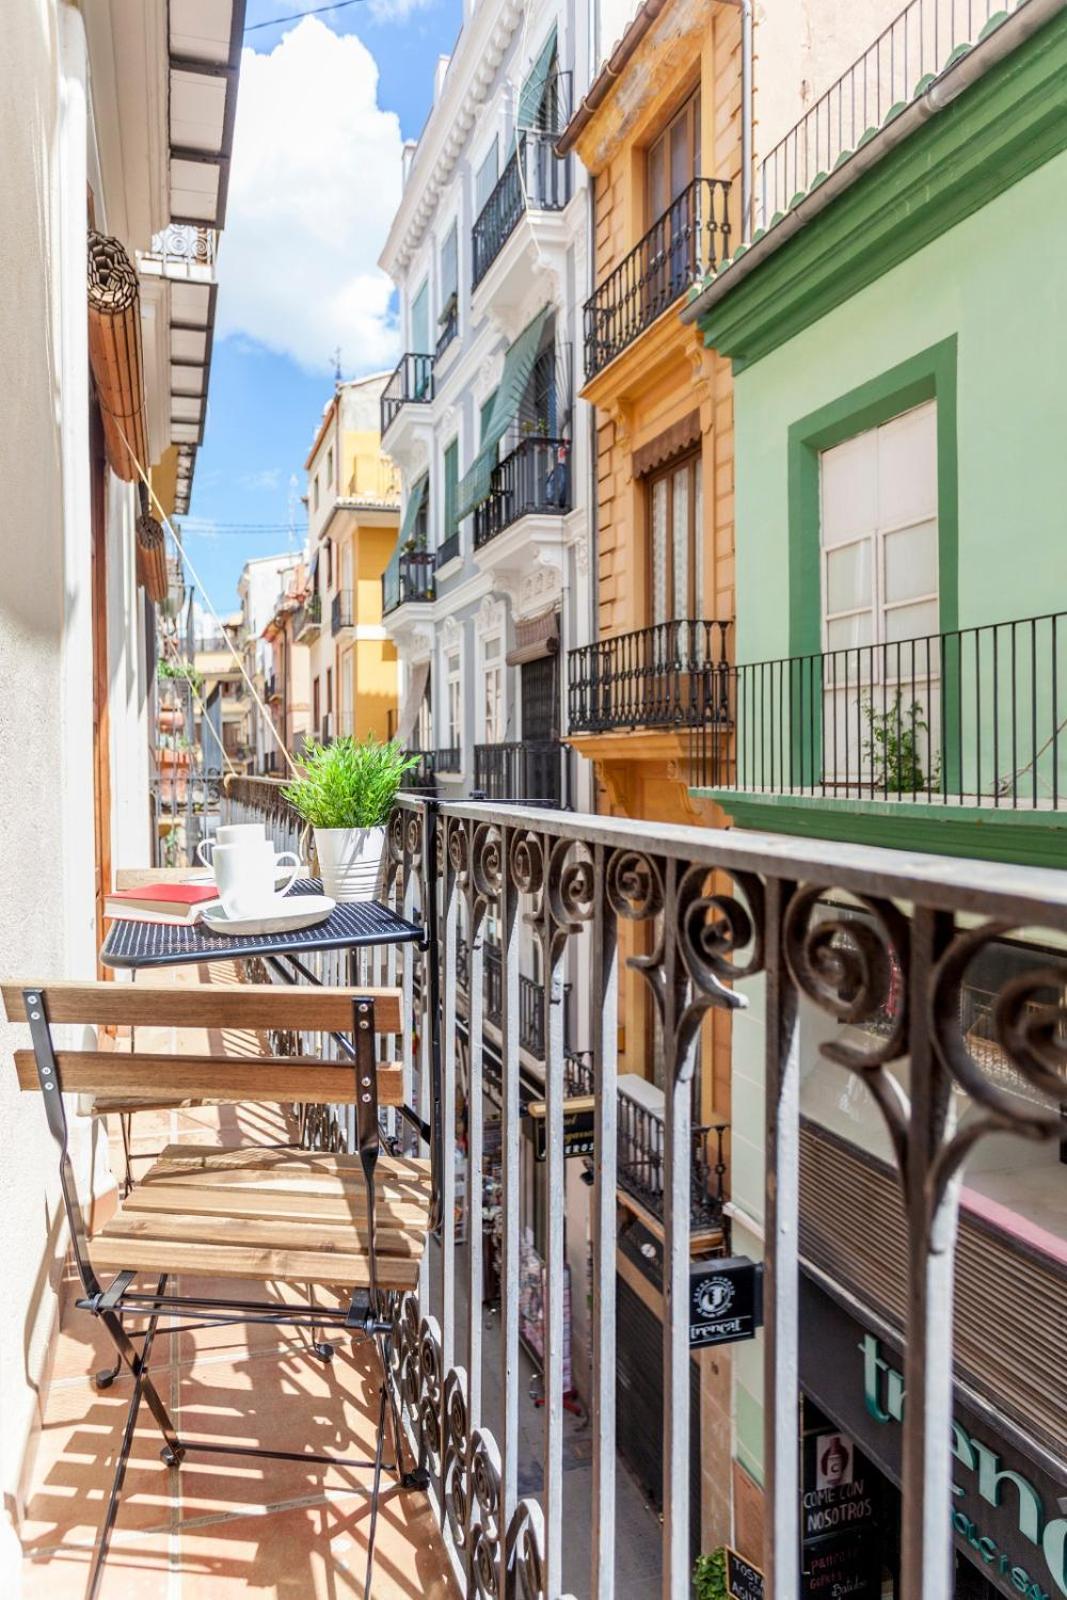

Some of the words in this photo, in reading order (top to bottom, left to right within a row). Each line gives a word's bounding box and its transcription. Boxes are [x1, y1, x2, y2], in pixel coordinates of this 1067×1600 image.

[803, 1486, 837, 1509] COME
[839, 1479, 864, 1500] CON
[807, 1497, 872, 1532] NOSOTROS
